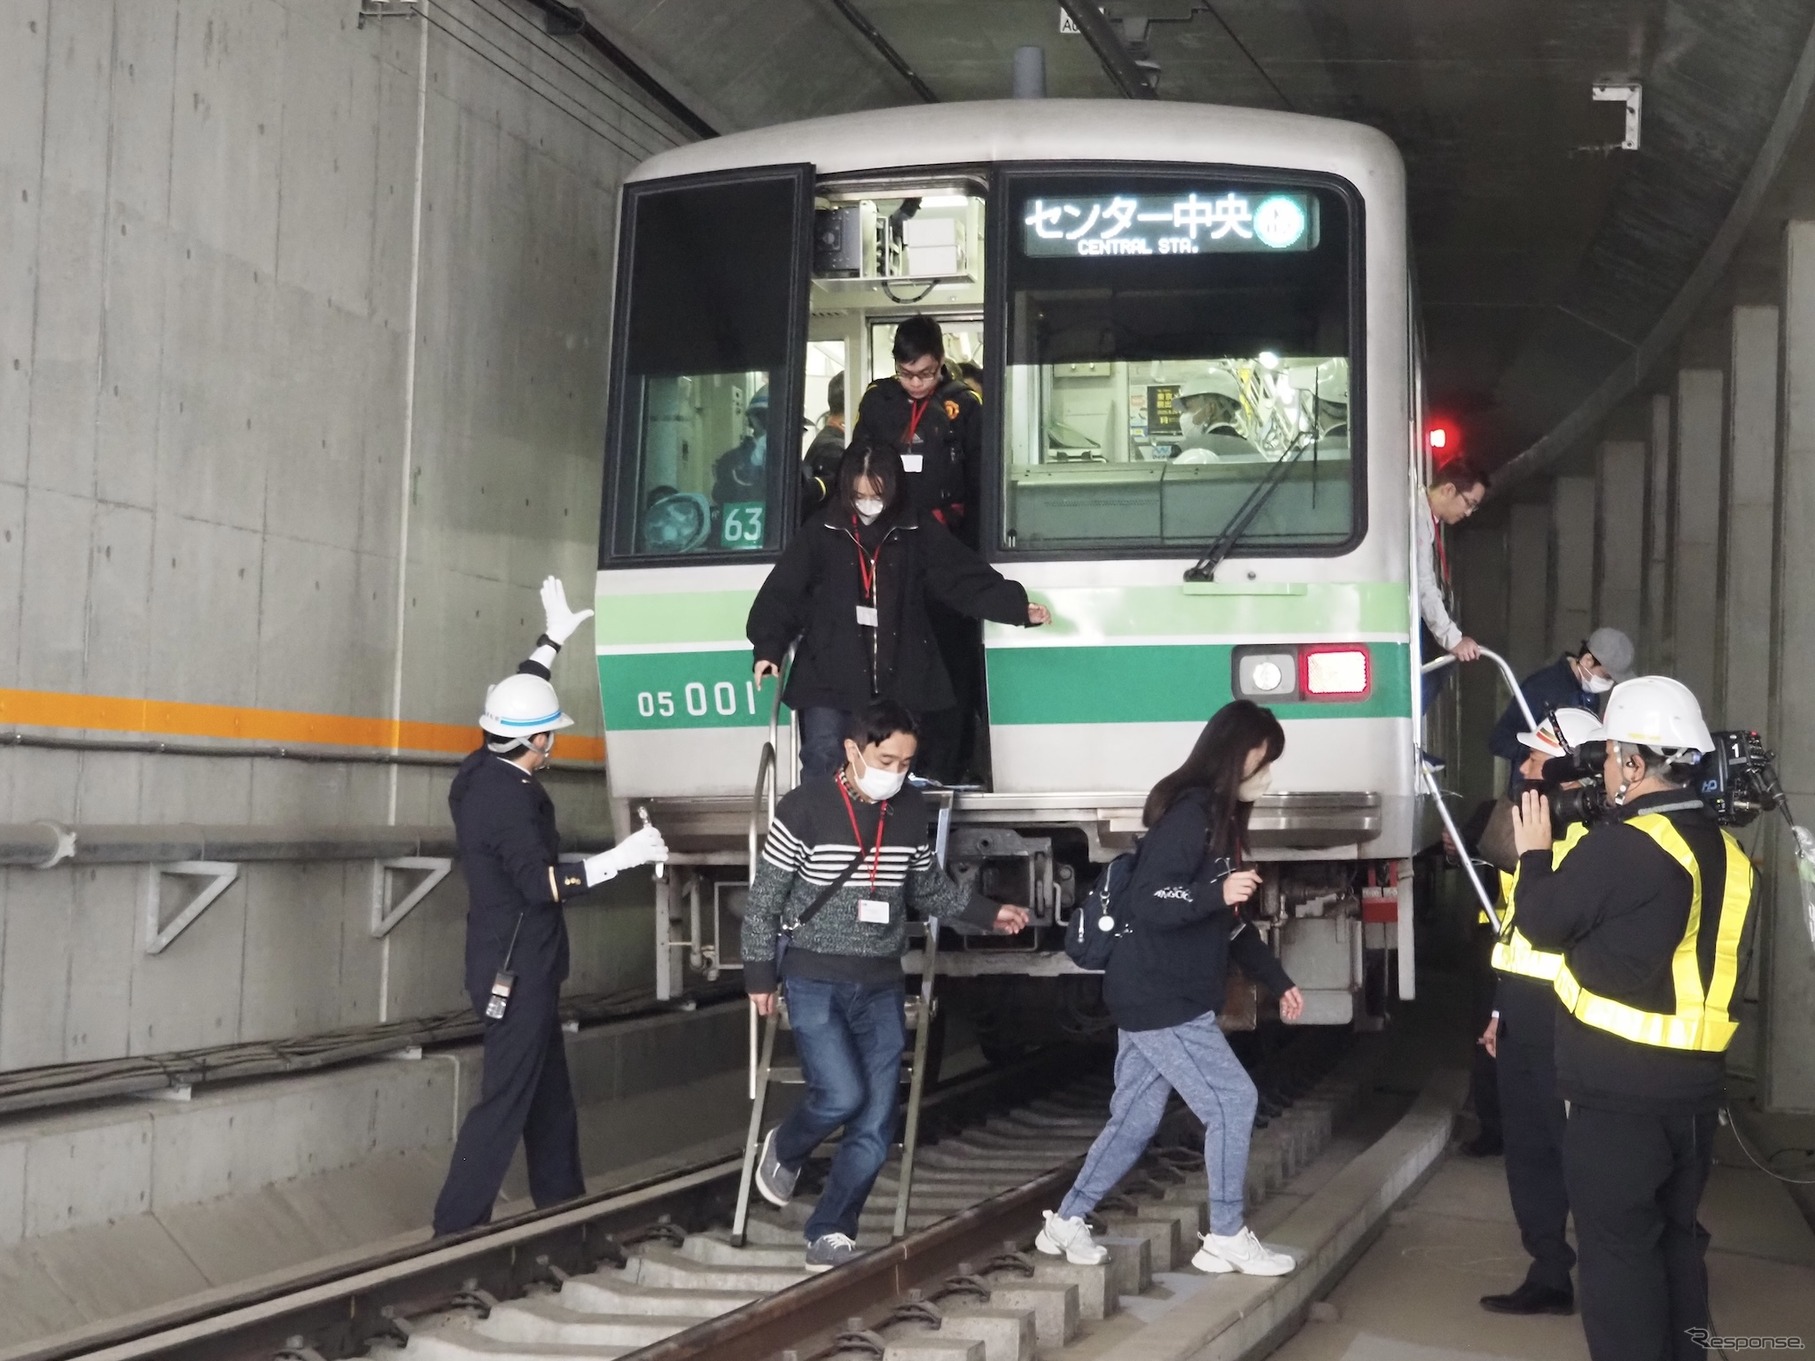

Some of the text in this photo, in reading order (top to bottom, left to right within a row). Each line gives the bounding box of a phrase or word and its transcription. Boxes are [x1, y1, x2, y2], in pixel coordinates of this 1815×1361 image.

[1025, 193, 1253, 239] センター中央
[1078, 238, 1153, 255] CENTRAL
[725, 507, 763, 541] 63
[1731, 743, 1740, 758] 1
